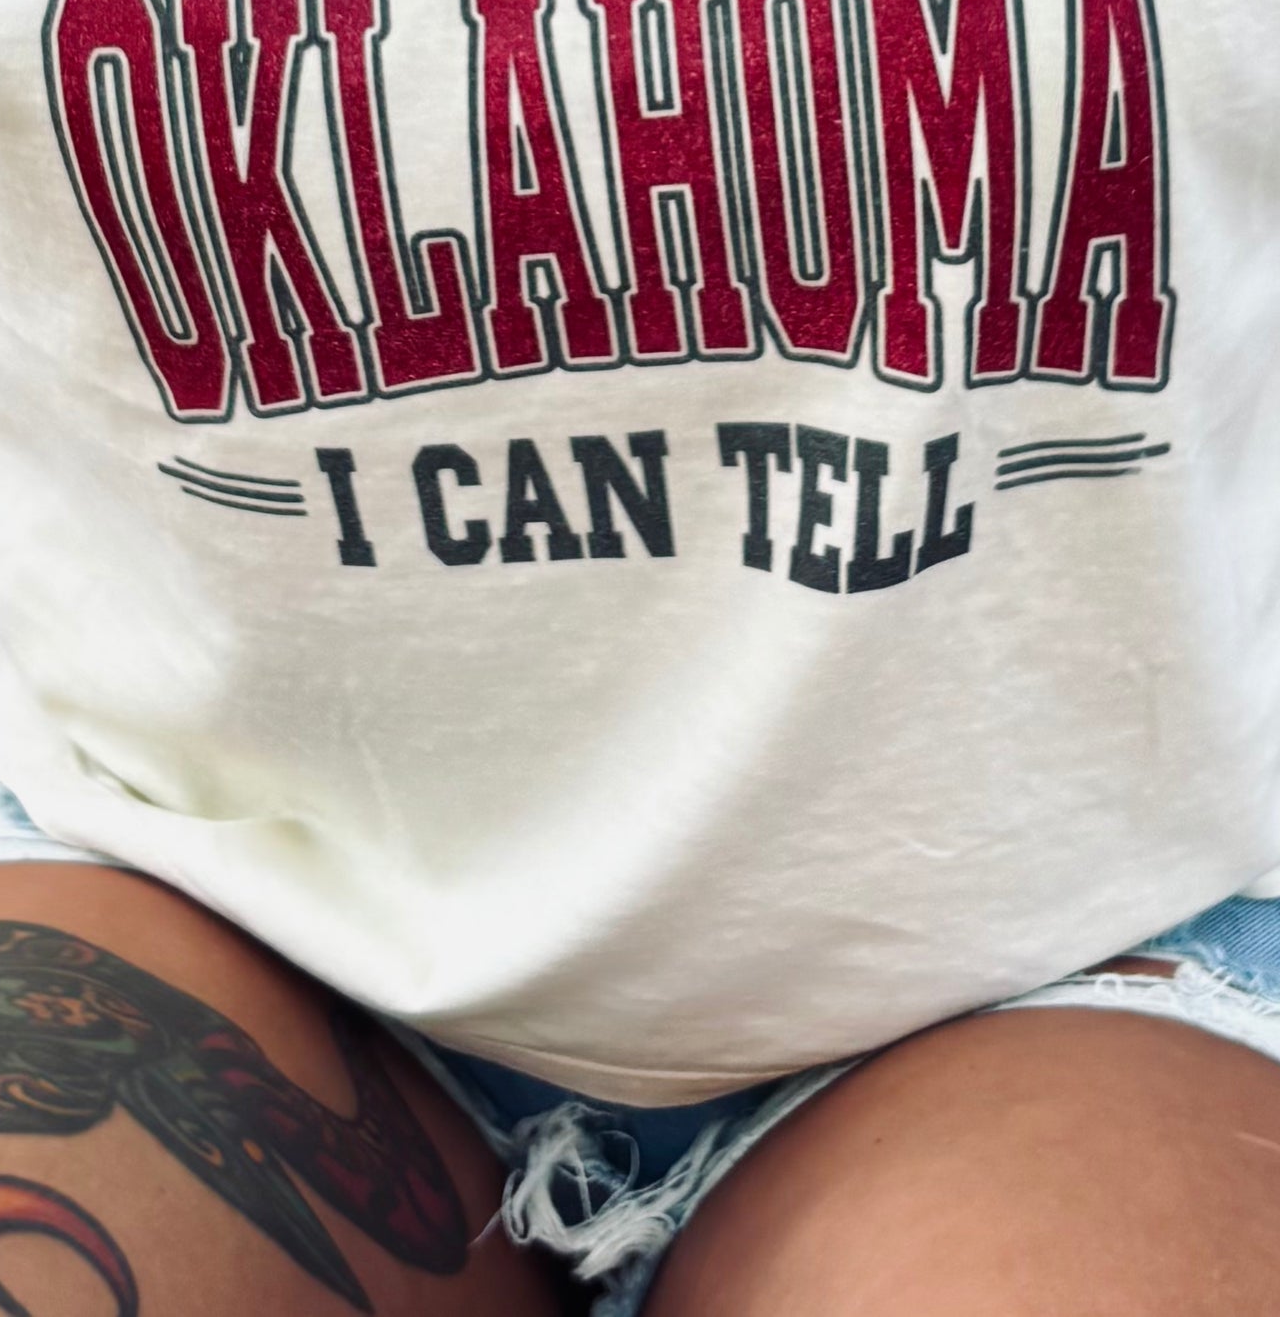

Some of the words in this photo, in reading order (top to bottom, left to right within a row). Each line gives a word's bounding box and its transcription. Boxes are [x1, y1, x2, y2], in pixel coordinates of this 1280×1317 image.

[315, 446, 376, 567] I
[411, 429, 677, 566] CAN
[716, 421, 975, 595] TELL
